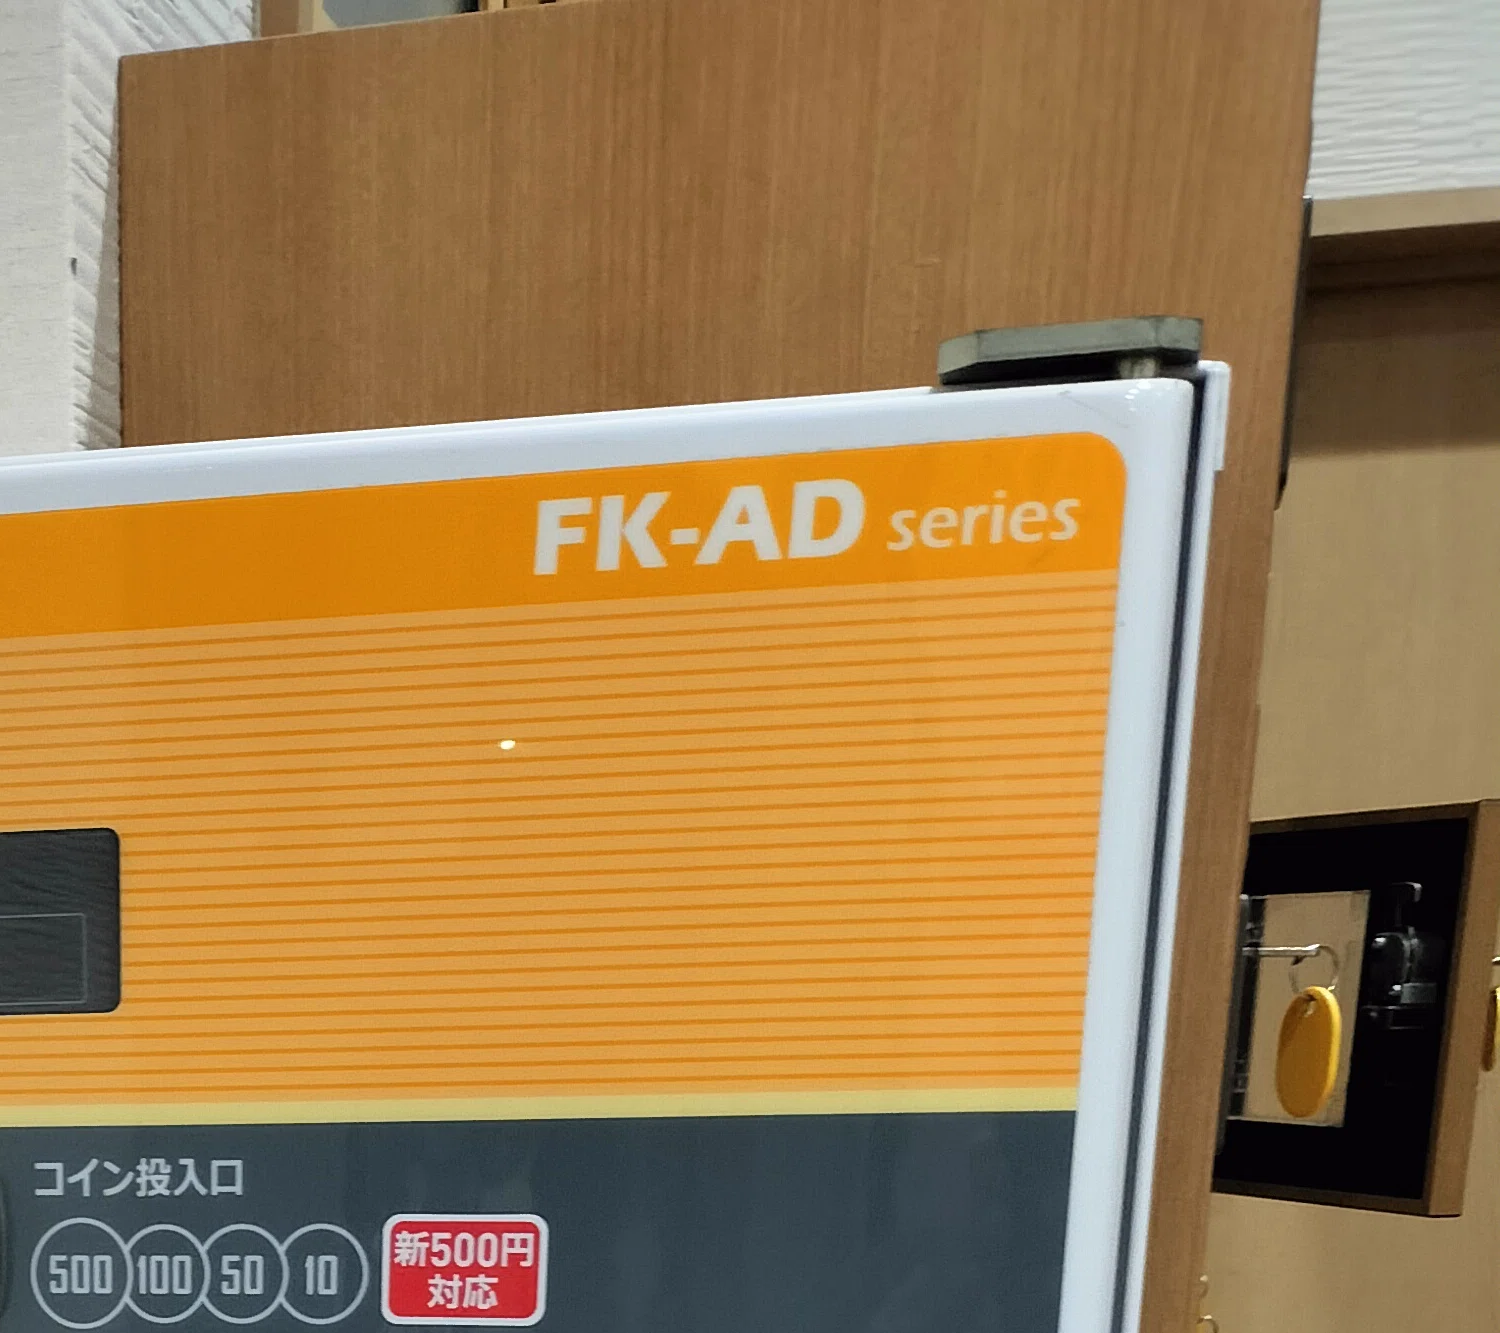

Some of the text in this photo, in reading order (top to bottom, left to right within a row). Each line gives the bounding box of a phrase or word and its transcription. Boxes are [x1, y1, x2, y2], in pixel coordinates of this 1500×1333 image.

[533, 479, 1080, 576] FK-AD series
[34, 1158, 245, 1197] コイン投入口
[394, 1231, 534, 1269] 新500円
[49, 1255, 338, 1295] 500 100 50 10
[428, 1274, 499, 1310] 対応
